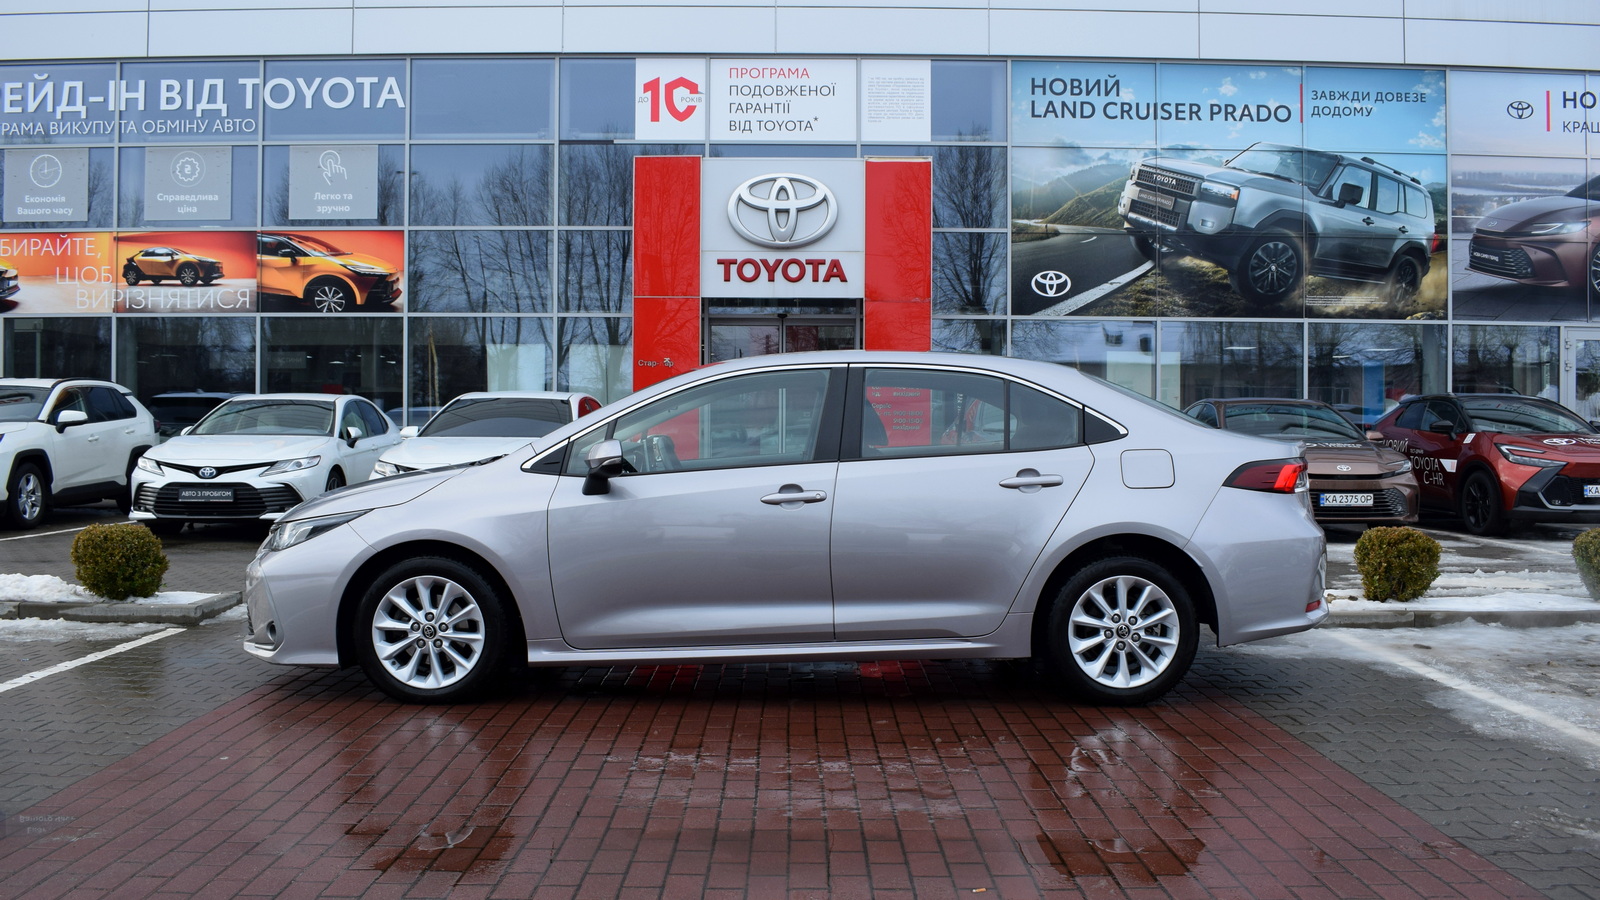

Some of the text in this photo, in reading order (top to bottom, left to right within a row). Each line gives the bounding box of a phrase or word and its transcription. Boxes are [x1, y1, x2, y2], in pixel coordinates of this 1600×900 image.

[728, 67, 811, 79] ПРОГРАМА
[728, 83, 837, 98] ПОДОВЖЕНОЇ
[1030, 74, 1121, 97] НОВИЙ
[160, 78, 228, 118] ВІД
[238, 76, 406, 110] TOYOTA
[1310, 89, 1428, 104] ЗАВЖДИ ДОВЕЗЕ
[1563, 91, 1597, 109] НО
[728, 99, 791, 114] ГАРАНТІЇ
[1030, 101, 1292, 123] LAND CRUISER PRADO
[1310, 105, 1373, 119] ДОДОМУ
[1, 118, 256, 136] РАМА ВИКУПУ ТА ОБМІНУ АВТО
[728, 120, 753, 134] ВІД
[1153, 174, 1176, 185] TOYOTA
[24, 195, 66, 204] Економія
[157, 193, 219, 202] Справедлива
[313, 192, 353, 201] Легко та
[17, 207, 73, 217] Вашого часу
[177, 205, 197, 215] ціна
[316, 203, 350, 213] зручно
[0, 233, 103, 260] БИРАЙТЕ,
[55, 265, 114, 288] ЩОБ
[716, 257, 849, 283] TOYOTA
[75, 288, 251, 309] ВИРІЗНЯТИСЯ
[1409, 455, 1440, 472] TOYOTA
[1423, 470, 1445, 486] C-HR
[1324, 494, 1338, 504] KA
[1338, 494, 1359, 504] 2375
